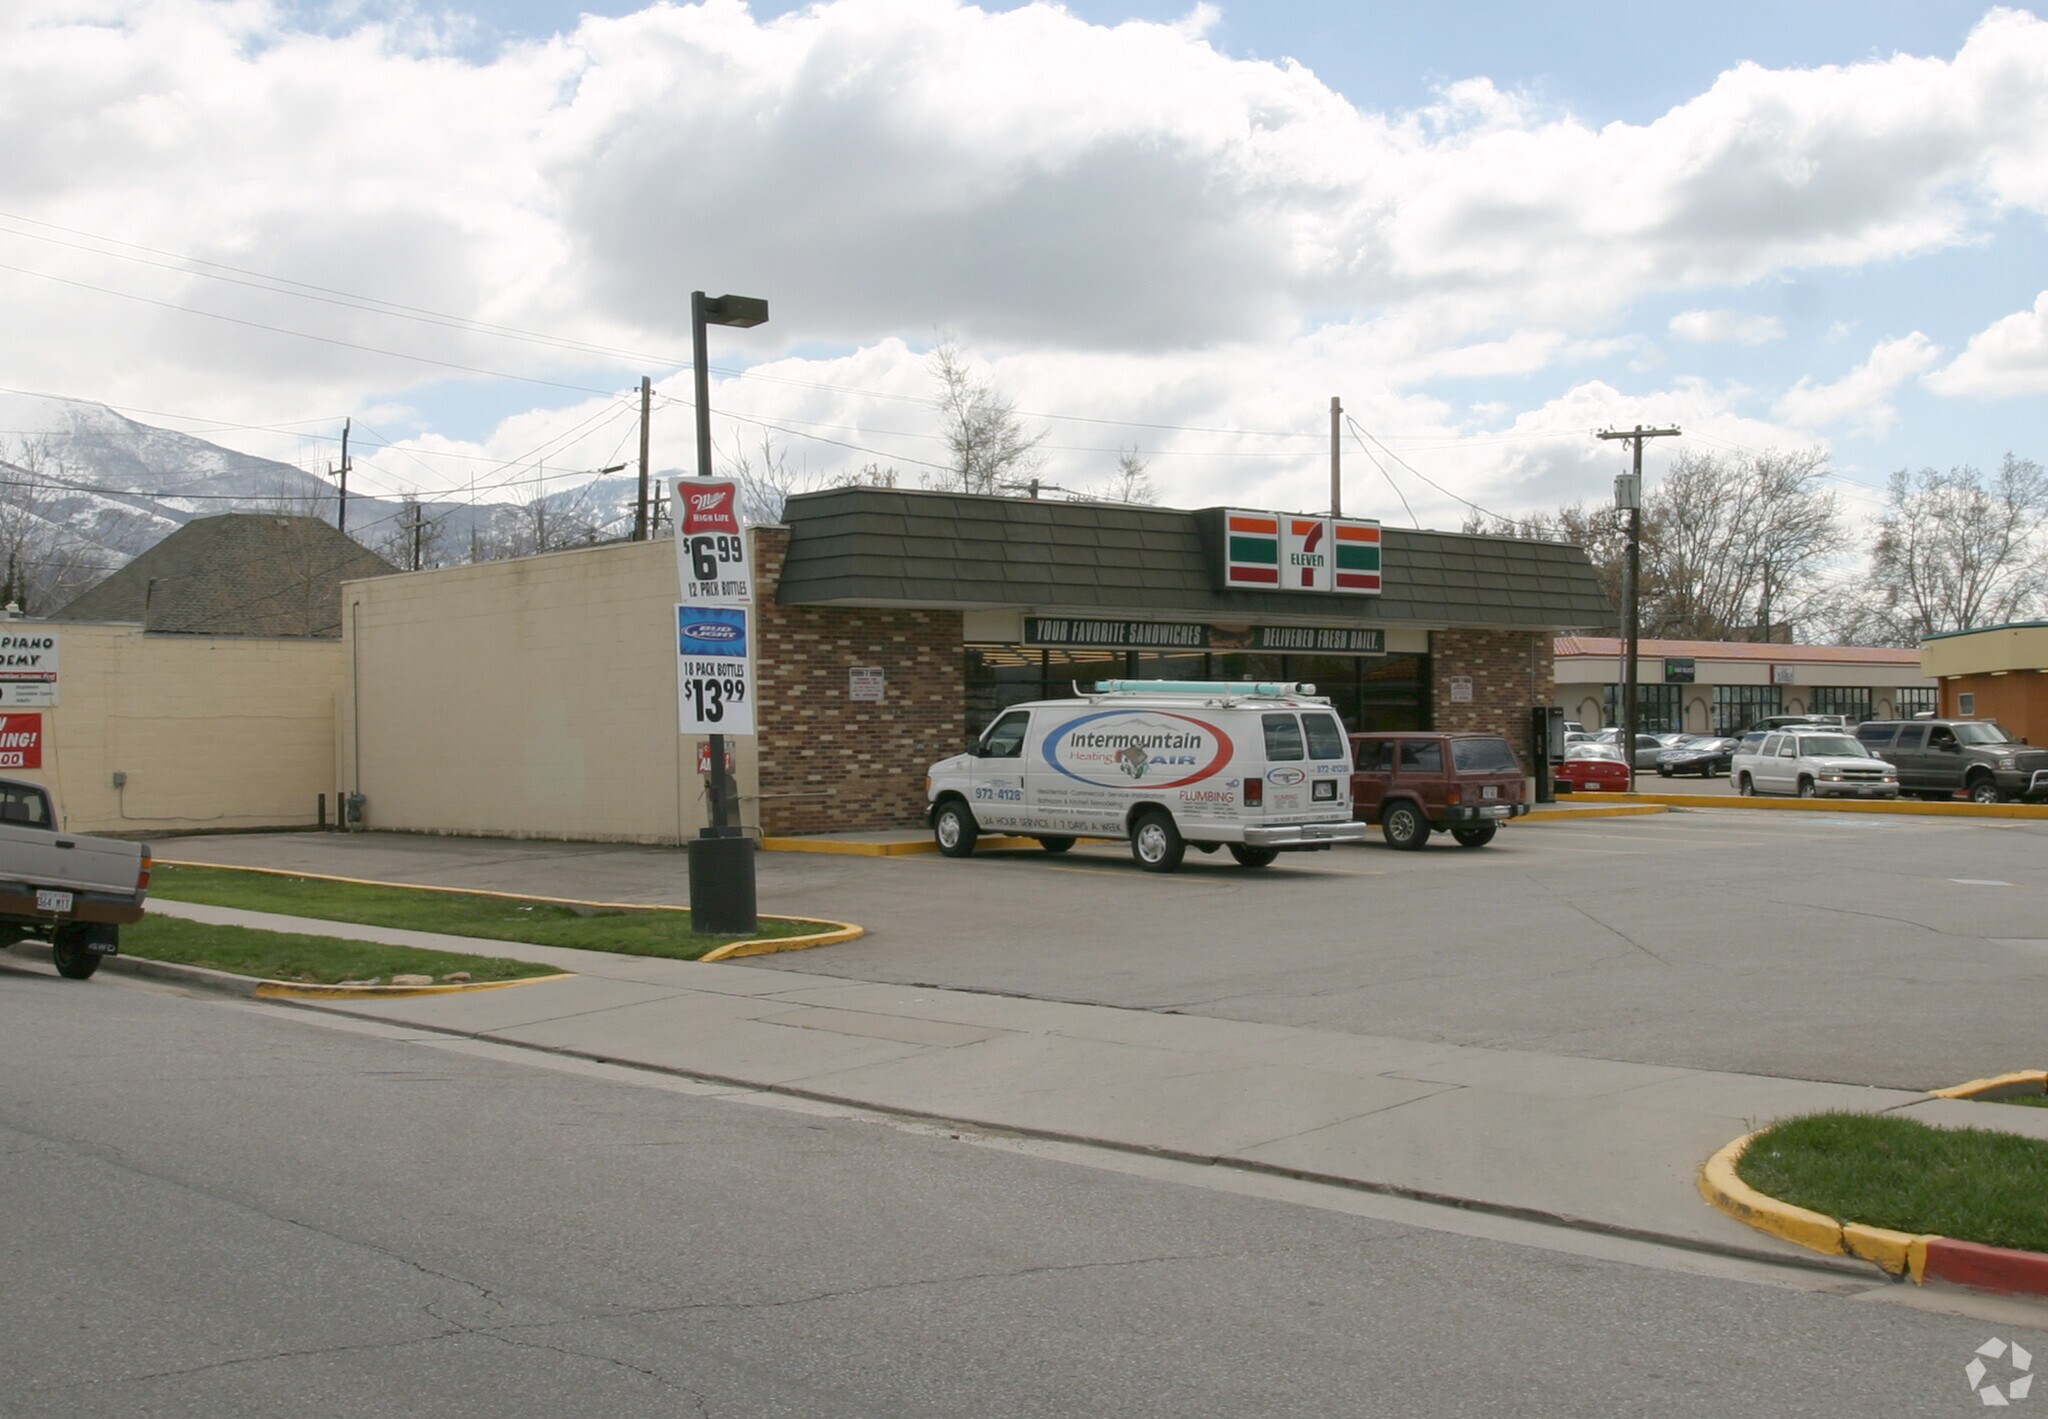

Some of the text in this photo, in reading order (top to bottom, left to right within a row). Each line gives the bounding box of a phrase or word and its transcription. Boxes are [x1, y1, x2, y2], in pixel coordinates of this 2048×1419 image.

[691, 492, 726, 511] Miller
[1291, 520, 1323, 587] 7
[688, 581, 747, 597] 12 PACK BOTTLES
[1037, 620, 1068, 641] YOUR
[1072, 621, 1126, 643] FAVORITE
[1129, 623, 1202, 645] SANDWICHES
[1263, 628, 1314, 648] DELIVERED
[1317, 629, 1347, 649] FRESH
[1, 637, 54, 649] PIANO
[684, 662, 744, 678] 18 PACK BOTTLES
[1070, 732, 1202, 749] Intermountain
[1070, 751, 1196, 765] Heating AIR
[1180, 790, 1234, 802] PLUMBING
[983, 816, 994, 825] 24
[997, 817, 1017, 827] HOUR
[1021, 818, 1049, 829] SERVICE
[1068, 821, 1088, 831] DAYS
[1091, 822, 1098, 830] A
[1101, 823, 1122, 832] WEEK
